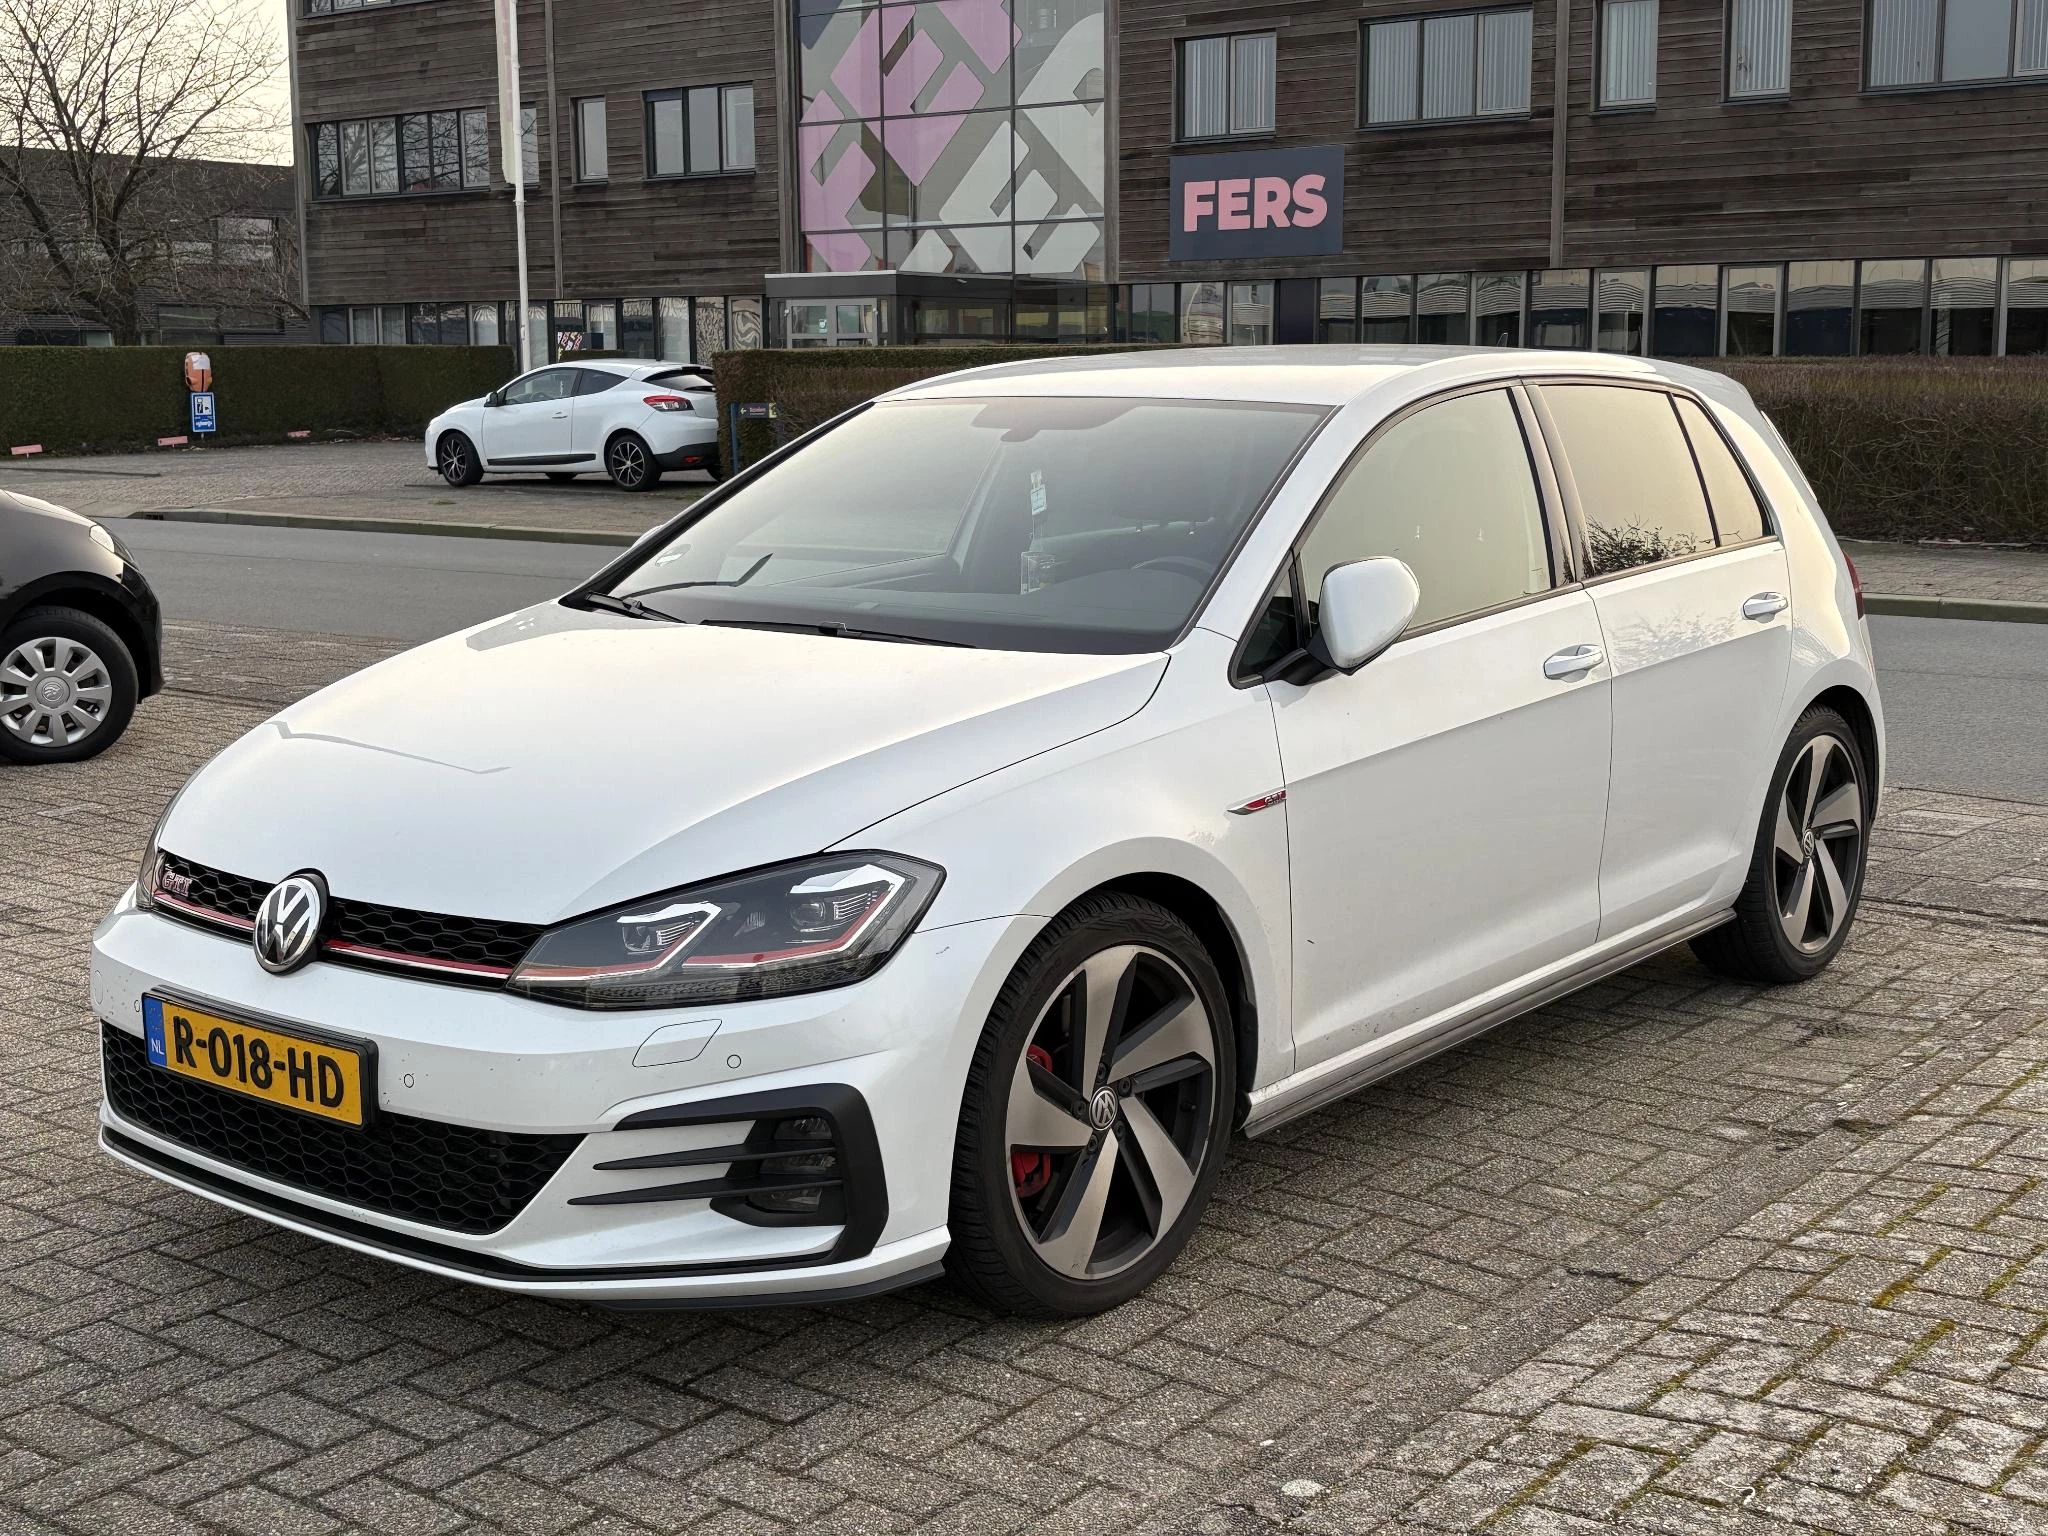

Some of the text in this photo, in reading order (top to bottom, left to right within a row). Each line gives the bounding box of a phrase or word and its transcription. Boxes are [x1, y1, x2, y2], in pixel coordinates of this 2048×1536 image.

[1184, 174, 1328, 232] FERS
[162, 868, 192, 898] GTI
[151, 1037, 165, 1056] NL
[173, 1015, 345, 1108] R-018-HD
